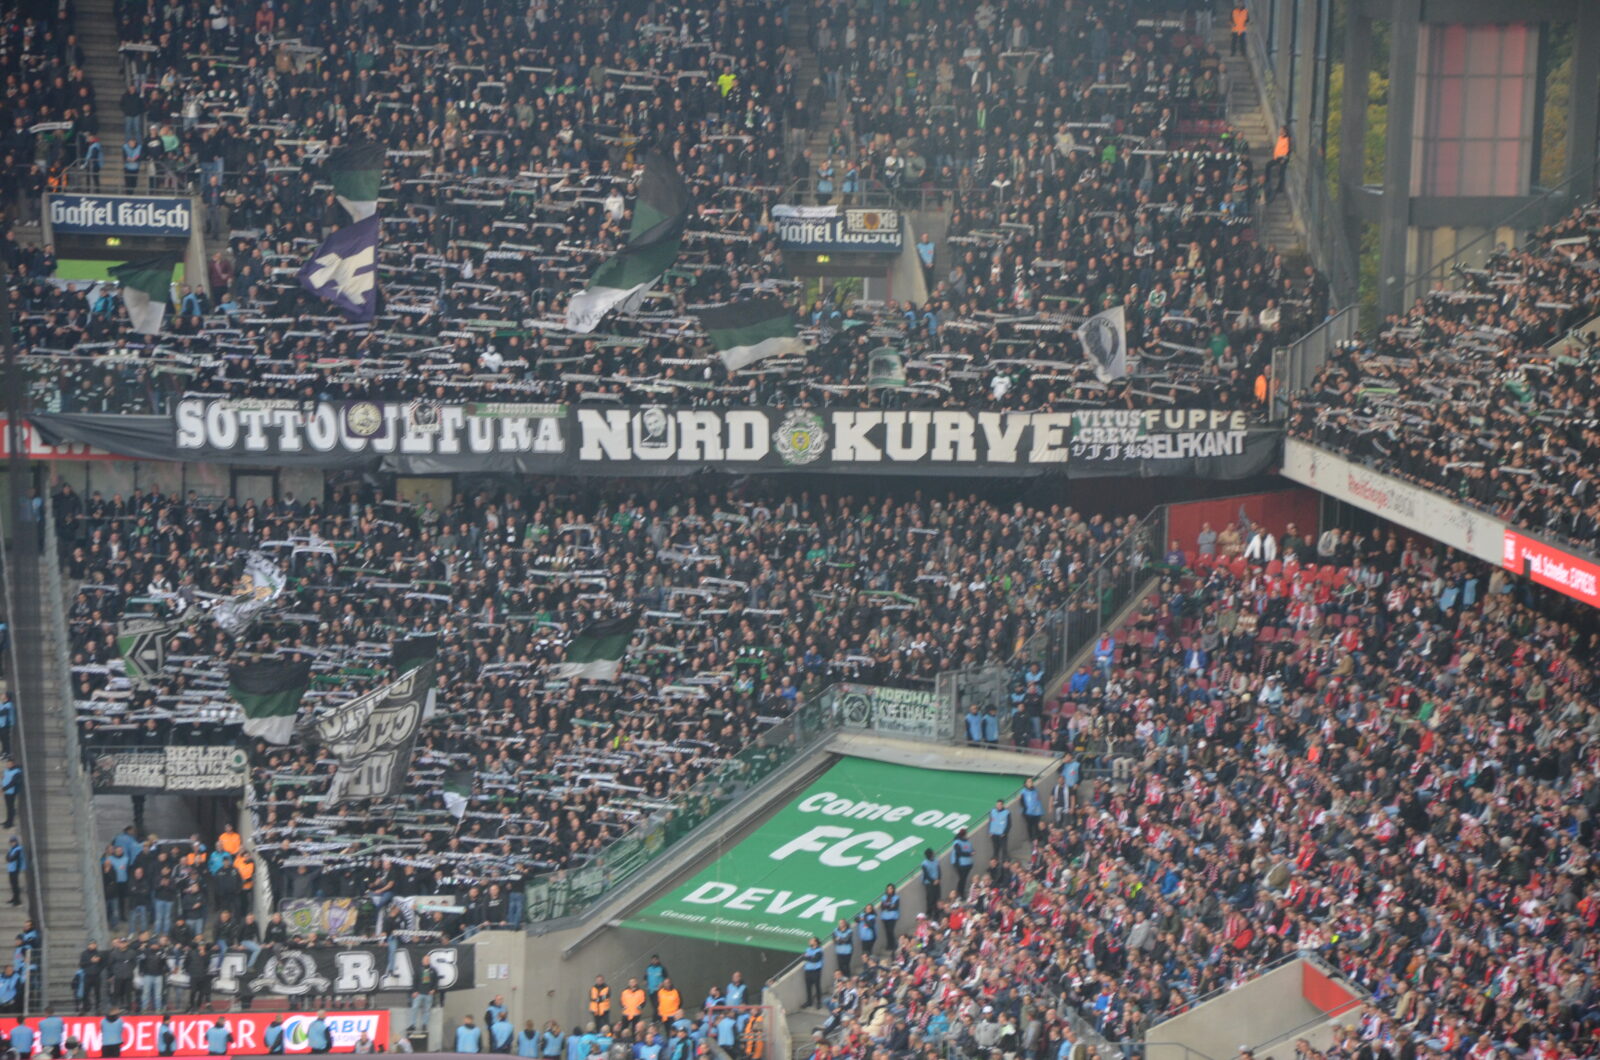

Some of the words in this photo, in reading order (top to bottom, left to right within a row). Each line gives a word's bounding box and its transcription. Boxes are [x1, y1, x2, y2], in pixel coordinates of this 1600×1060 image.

[51, 197, 116, 227] Gaffel
[118, 202, 190, 231] Kölsch
[1077, 409, 1142, 427] VITUS
[577, 409, 770, 461] NORD
[832, 411, 1072, 463] KURVE
[1077, 428, 1140, 444] CREW
[1142, 431, 1248, 459] SELFKANT
[164, 760, 232, 775] SERVICE
[798, 791, 914, 823] Come
[769, 825, 925, 871] FC!
[682, 880, 858, 922] DEVK
